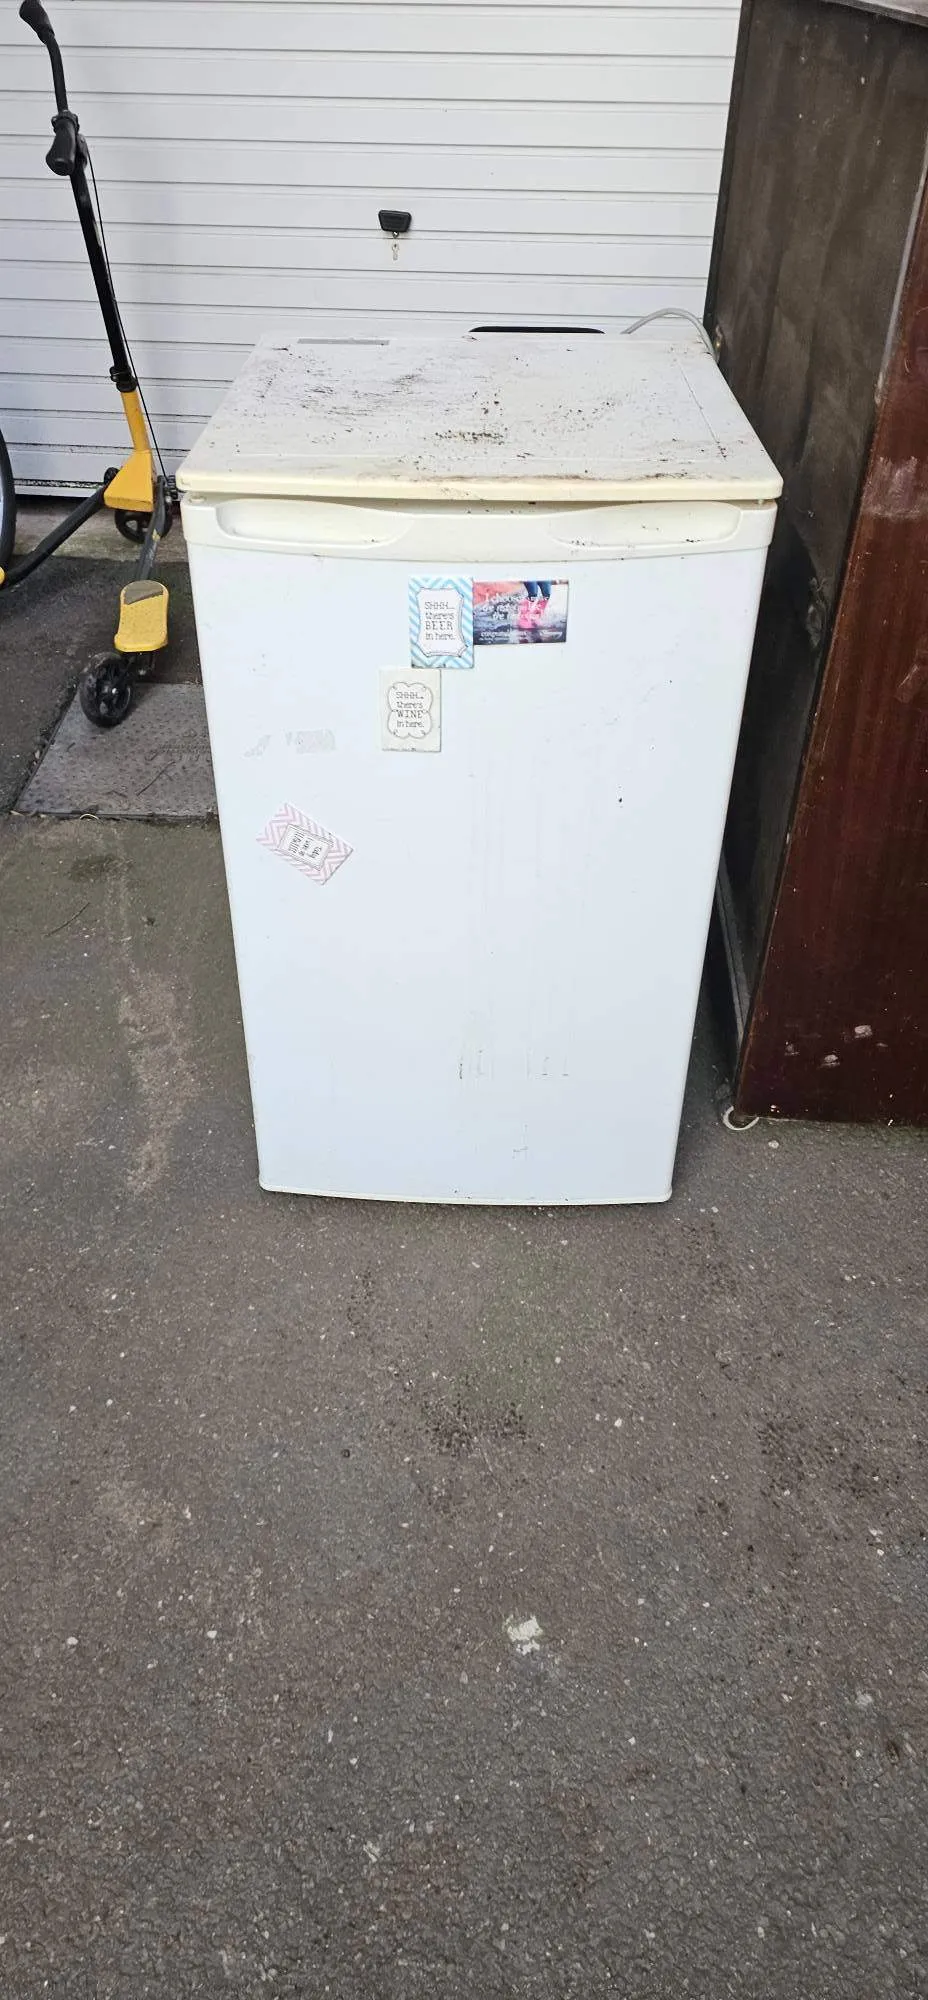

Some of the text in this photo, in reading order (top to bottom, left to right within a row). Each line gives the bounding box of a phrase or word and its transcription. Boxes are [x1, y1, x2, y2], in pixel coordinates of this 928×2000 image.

[425, 612, 455, 620] there's
[425, 621, 453, 630] BEER
[396, 701, 424, 709] there's
[397, 710, 424, 719] WINE
